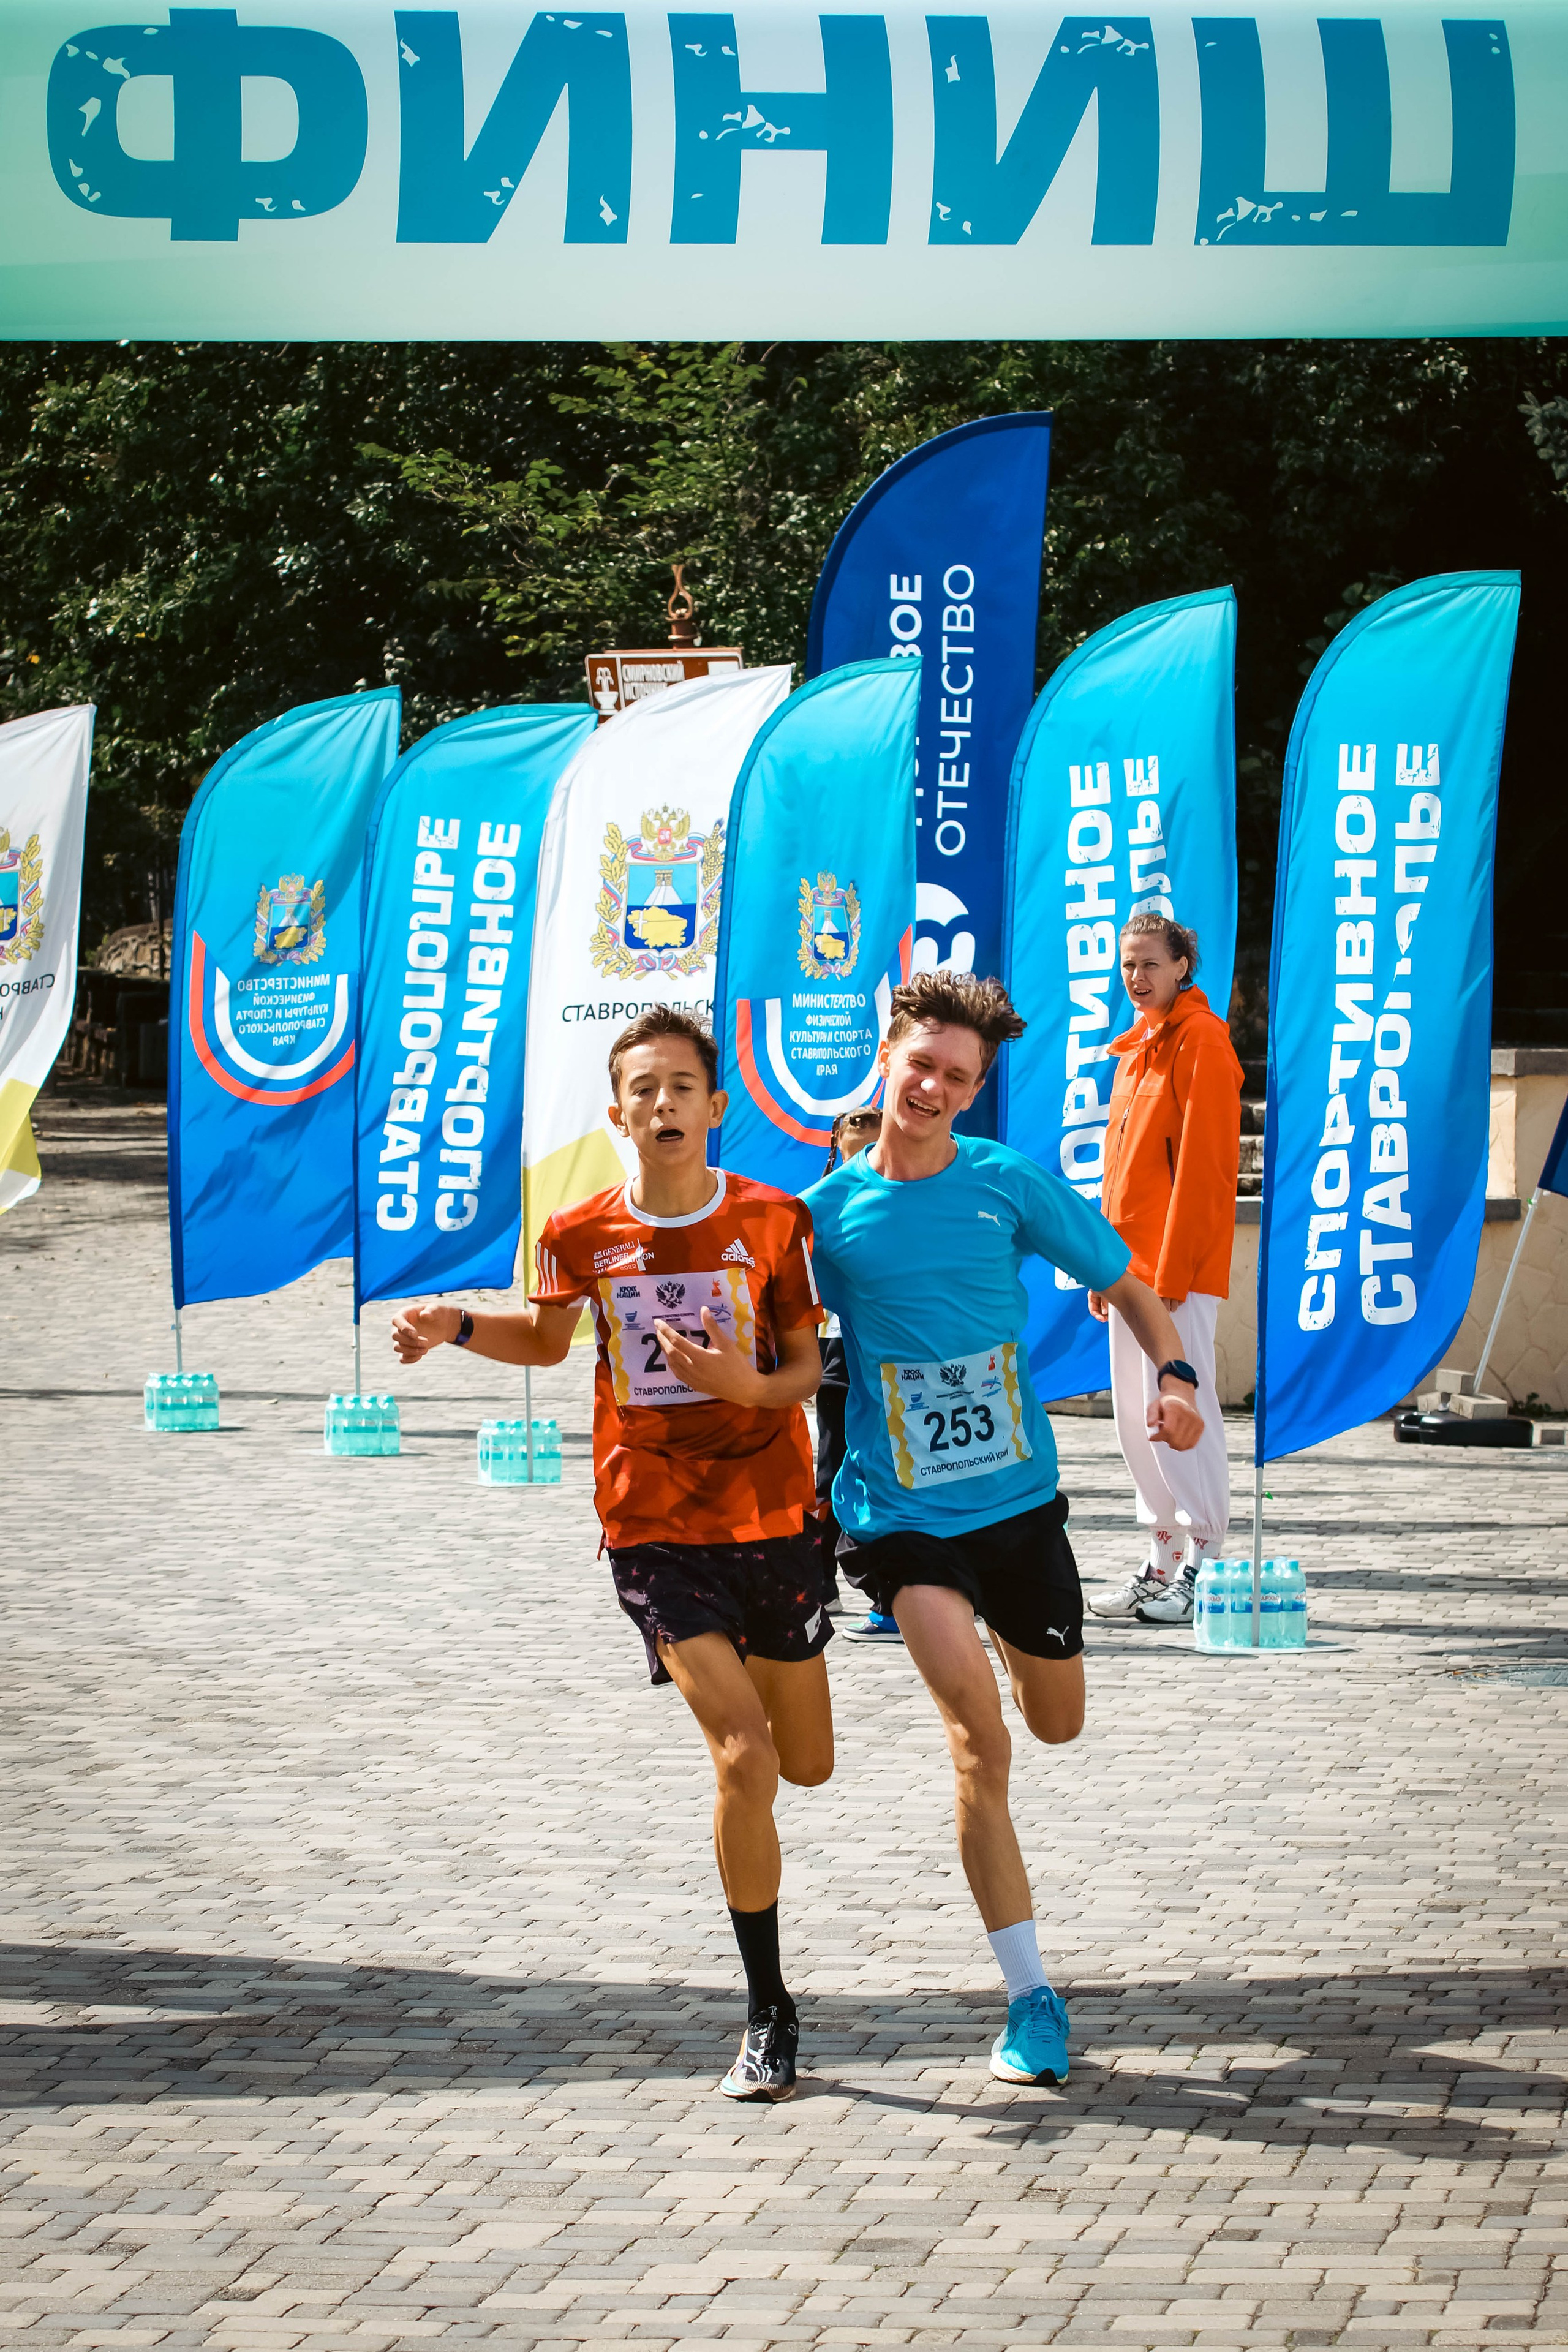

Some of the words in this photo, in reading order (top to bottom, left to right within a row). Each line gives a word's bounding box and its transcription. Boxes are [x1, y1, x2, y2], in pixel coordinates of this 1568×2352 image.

[47, 9, 1517, 246] ФИНИШ
[935, 564, 975, 856] ОТЕЧЕСТВО
[792, 993, 866, 1008] МИНИСТЕРСТВО
[805, 1011, 851, 1027] ФИЗИЧЕСКОЙ
[1054, 761, 1116, 1291] ОРТИВНОЕ
[834, 1028, 873, 1042] СПОРТА
[1298, 743, 1377, 1332] СПОРТИВНОЕ
[816, 1064, 838, 1076] КРАЯ
[603, 1241, 635, 1256] GENERALI
[594, 1253, 629, 1268] BERLINER
[721, 1251, 755, 1268] adidas
[641, 1330, 710, 1373] 27
[634, 1384, 696, 1396] СТАВРОПОЛЬС
[924, 1404, 995, 1452] 253
[921, 1452, 995, 1476] СТАВРОПОЛЬСКИЙ
